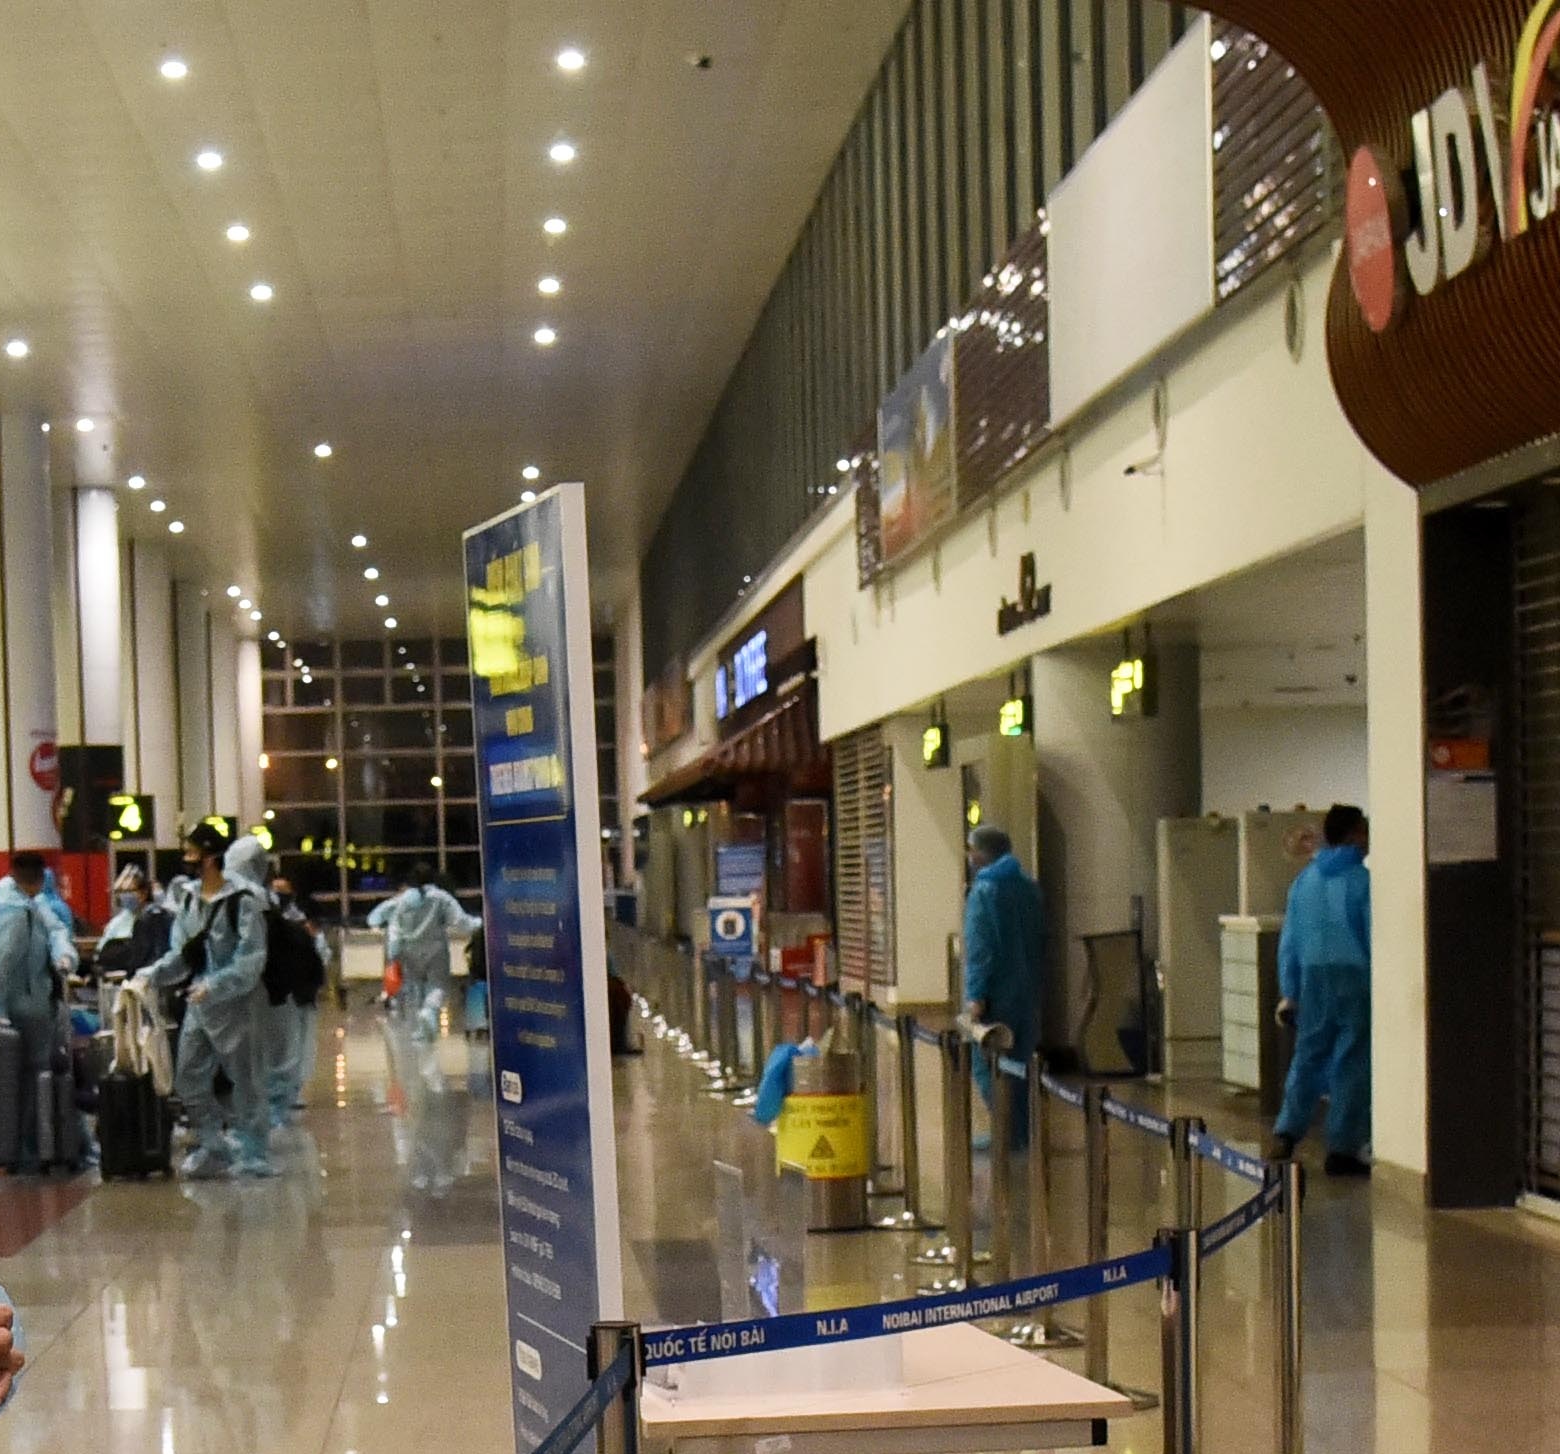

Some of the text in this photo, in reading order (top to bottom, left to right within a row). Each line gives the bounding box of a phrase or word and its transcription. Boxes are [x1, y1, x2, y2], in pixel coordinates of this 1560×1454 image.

[688, 1328, 708, 1353] TẾ
[710, 1329, 737, 1354] NỘI
[740, 1325, 765, 1347] BÀI
[816, 1318, 849, 1336] N.I.A
[882, 1310, 922, 1330] NOIBAI
[924, 1294, 1013, 1323] INTERNATIONAL
[1014, 1283, 1059, 1307] AIRPORT
